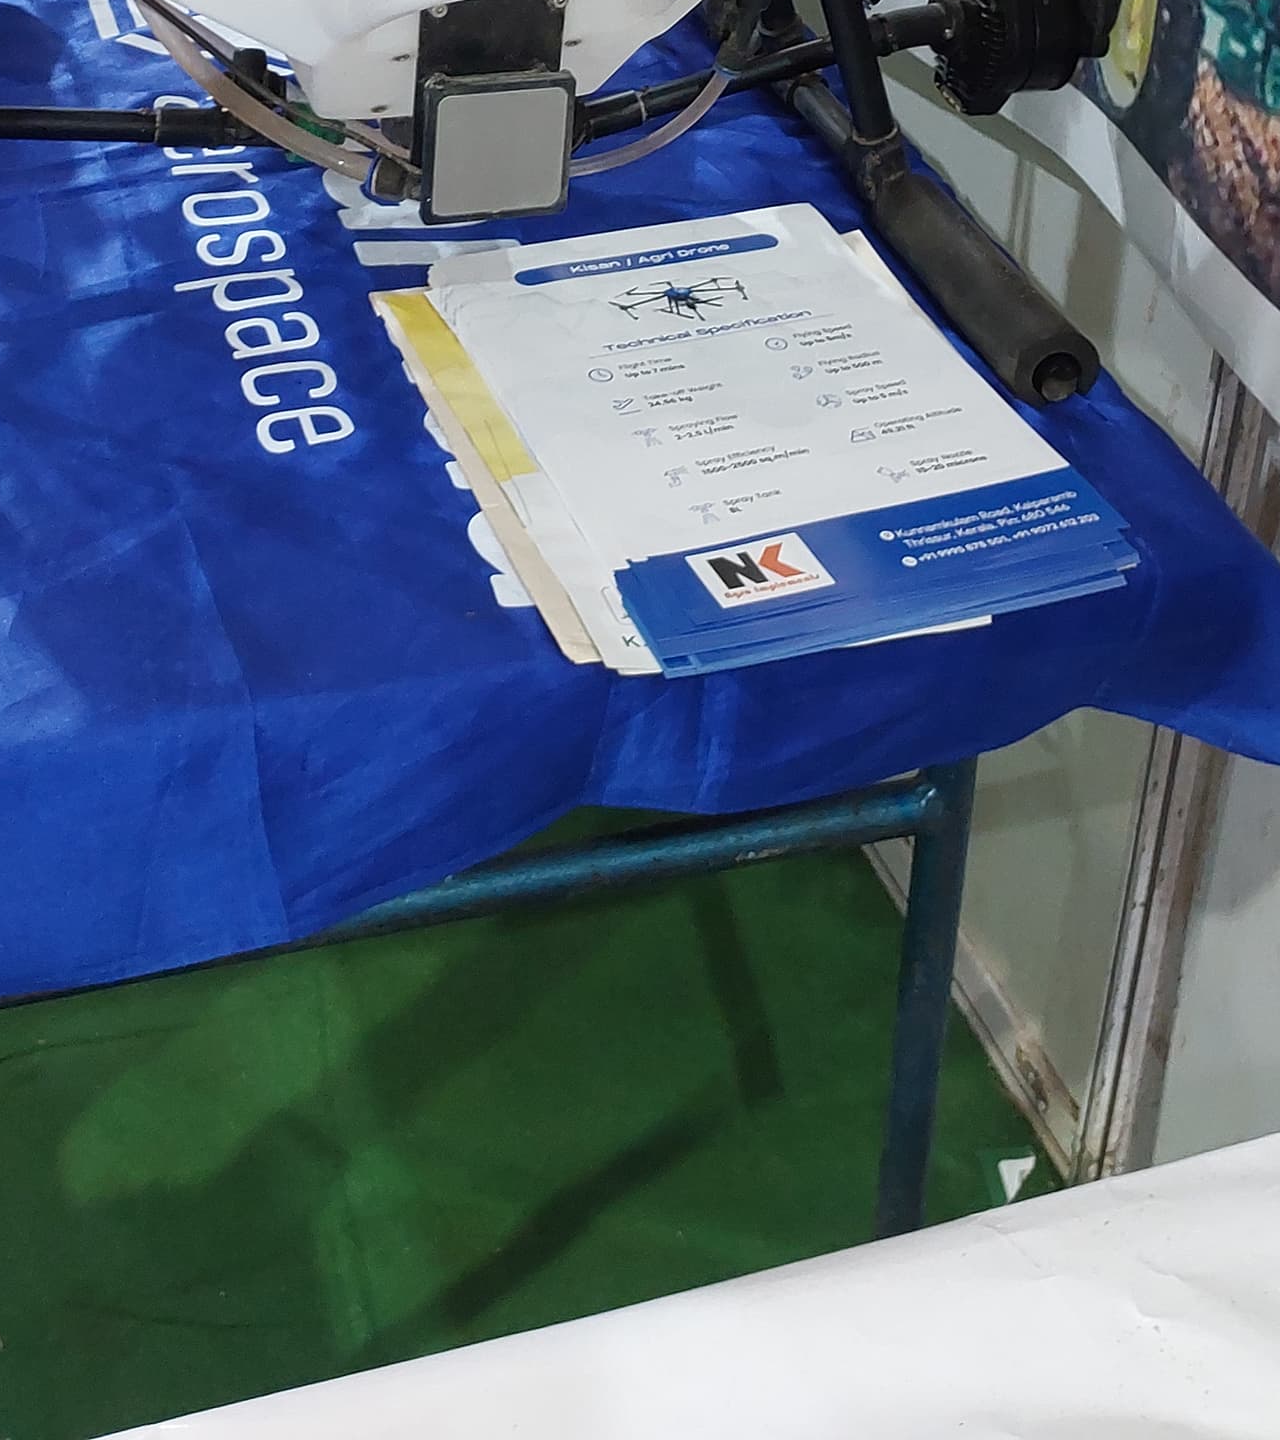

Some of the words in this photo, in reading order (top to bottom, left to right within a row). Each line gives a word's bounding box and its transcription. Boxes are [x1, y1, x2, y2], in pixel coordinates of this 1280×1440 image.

[154, 95, 356, 454] rospace
[570, 261, 621, 274] Kisan
[638, 251, 674, 265] Agri
[677, 243, 730, 257] Drone
[604, 331, 691, 351] Technical
[696, 310, 812, 336] Specification
[707, 542, 805, 590] NK
